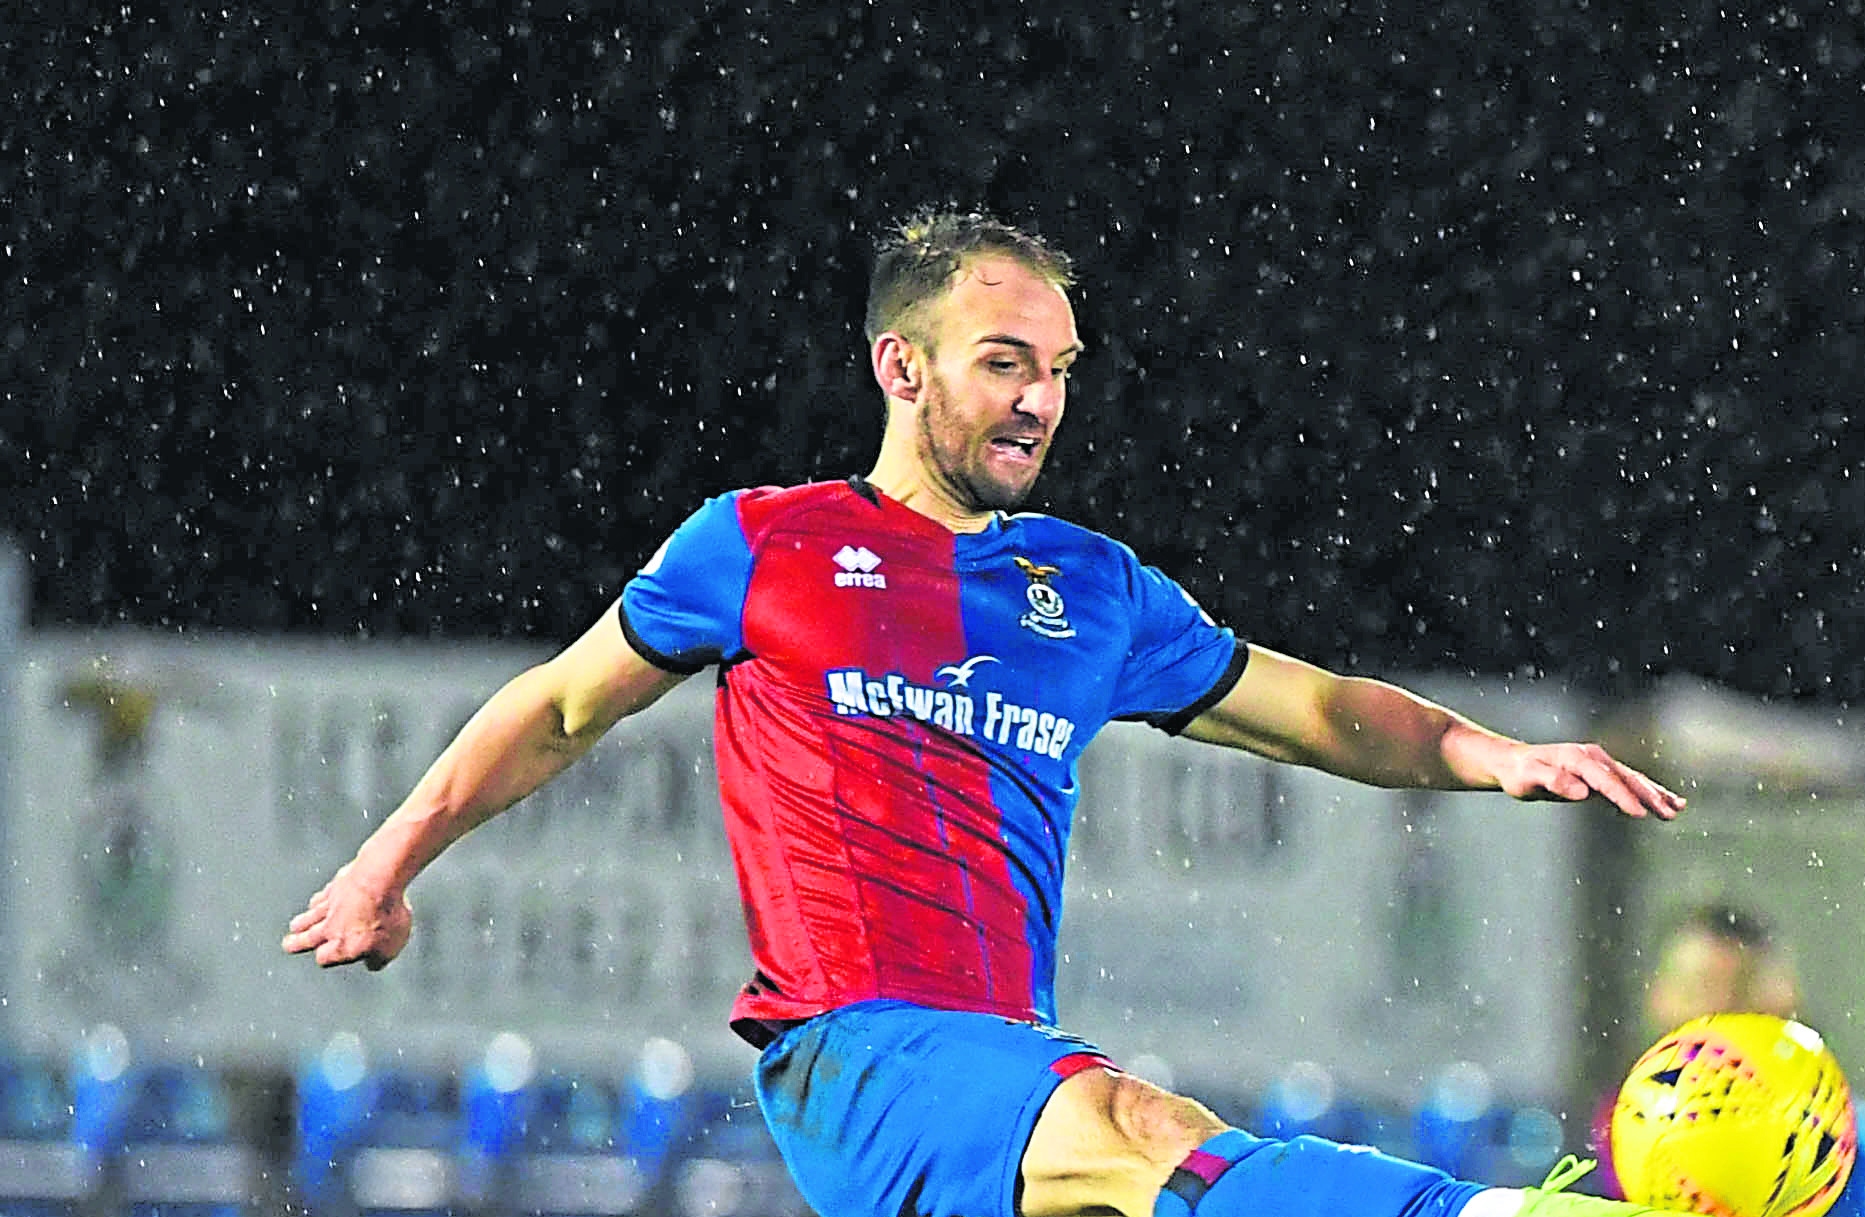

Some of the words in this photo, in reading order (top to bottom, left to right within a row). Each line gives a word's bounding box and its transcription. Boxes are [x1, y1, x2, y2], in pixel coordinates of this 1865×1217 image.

[834, 572, 887, 589] errea
[827, 671, 975, 736] McEwan
[983, 691, 1075, 762] Fraser
